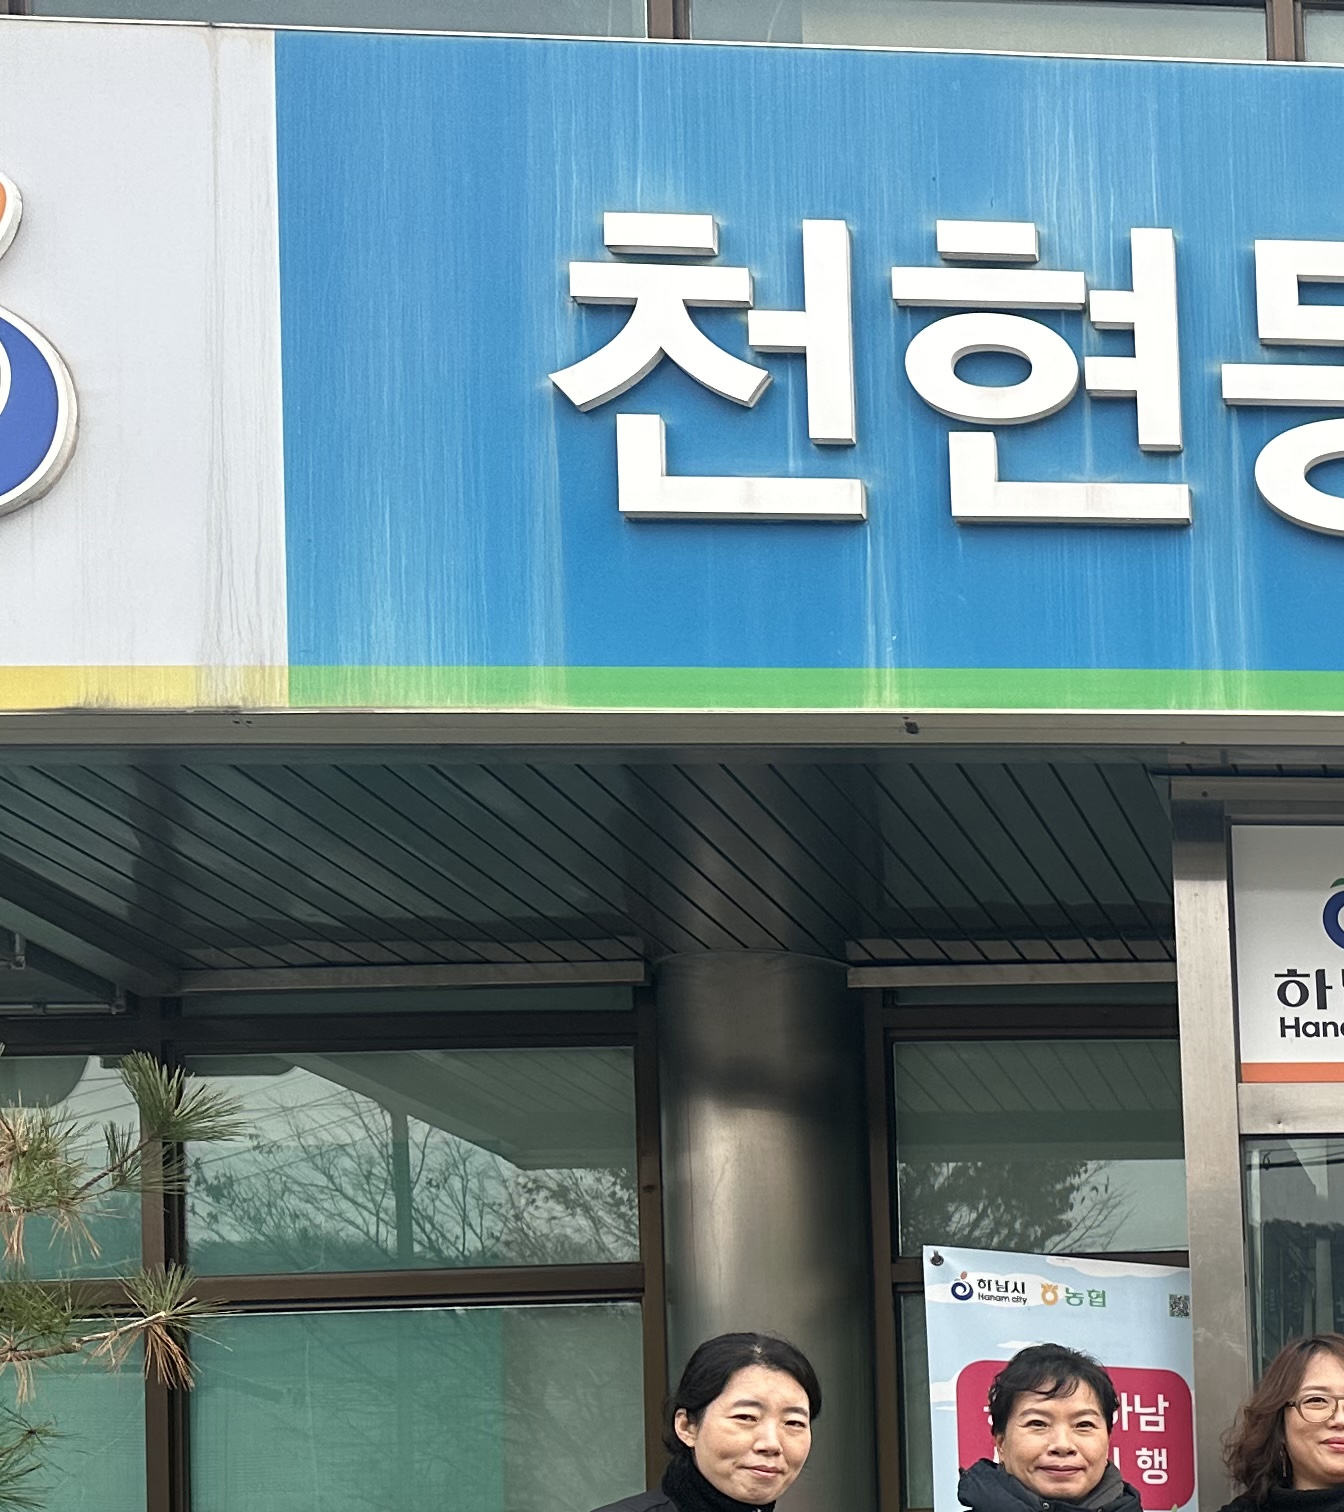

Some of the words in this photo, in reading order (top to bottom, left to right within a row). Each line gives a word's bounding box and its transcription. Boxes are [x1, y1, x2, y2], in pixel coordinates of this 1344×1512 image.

[977, 1278, 1026, 1295] 하남시
[978, 1294, 1010, 1303] Hanam
[1065, 1288, 1107, 1308] 농협
